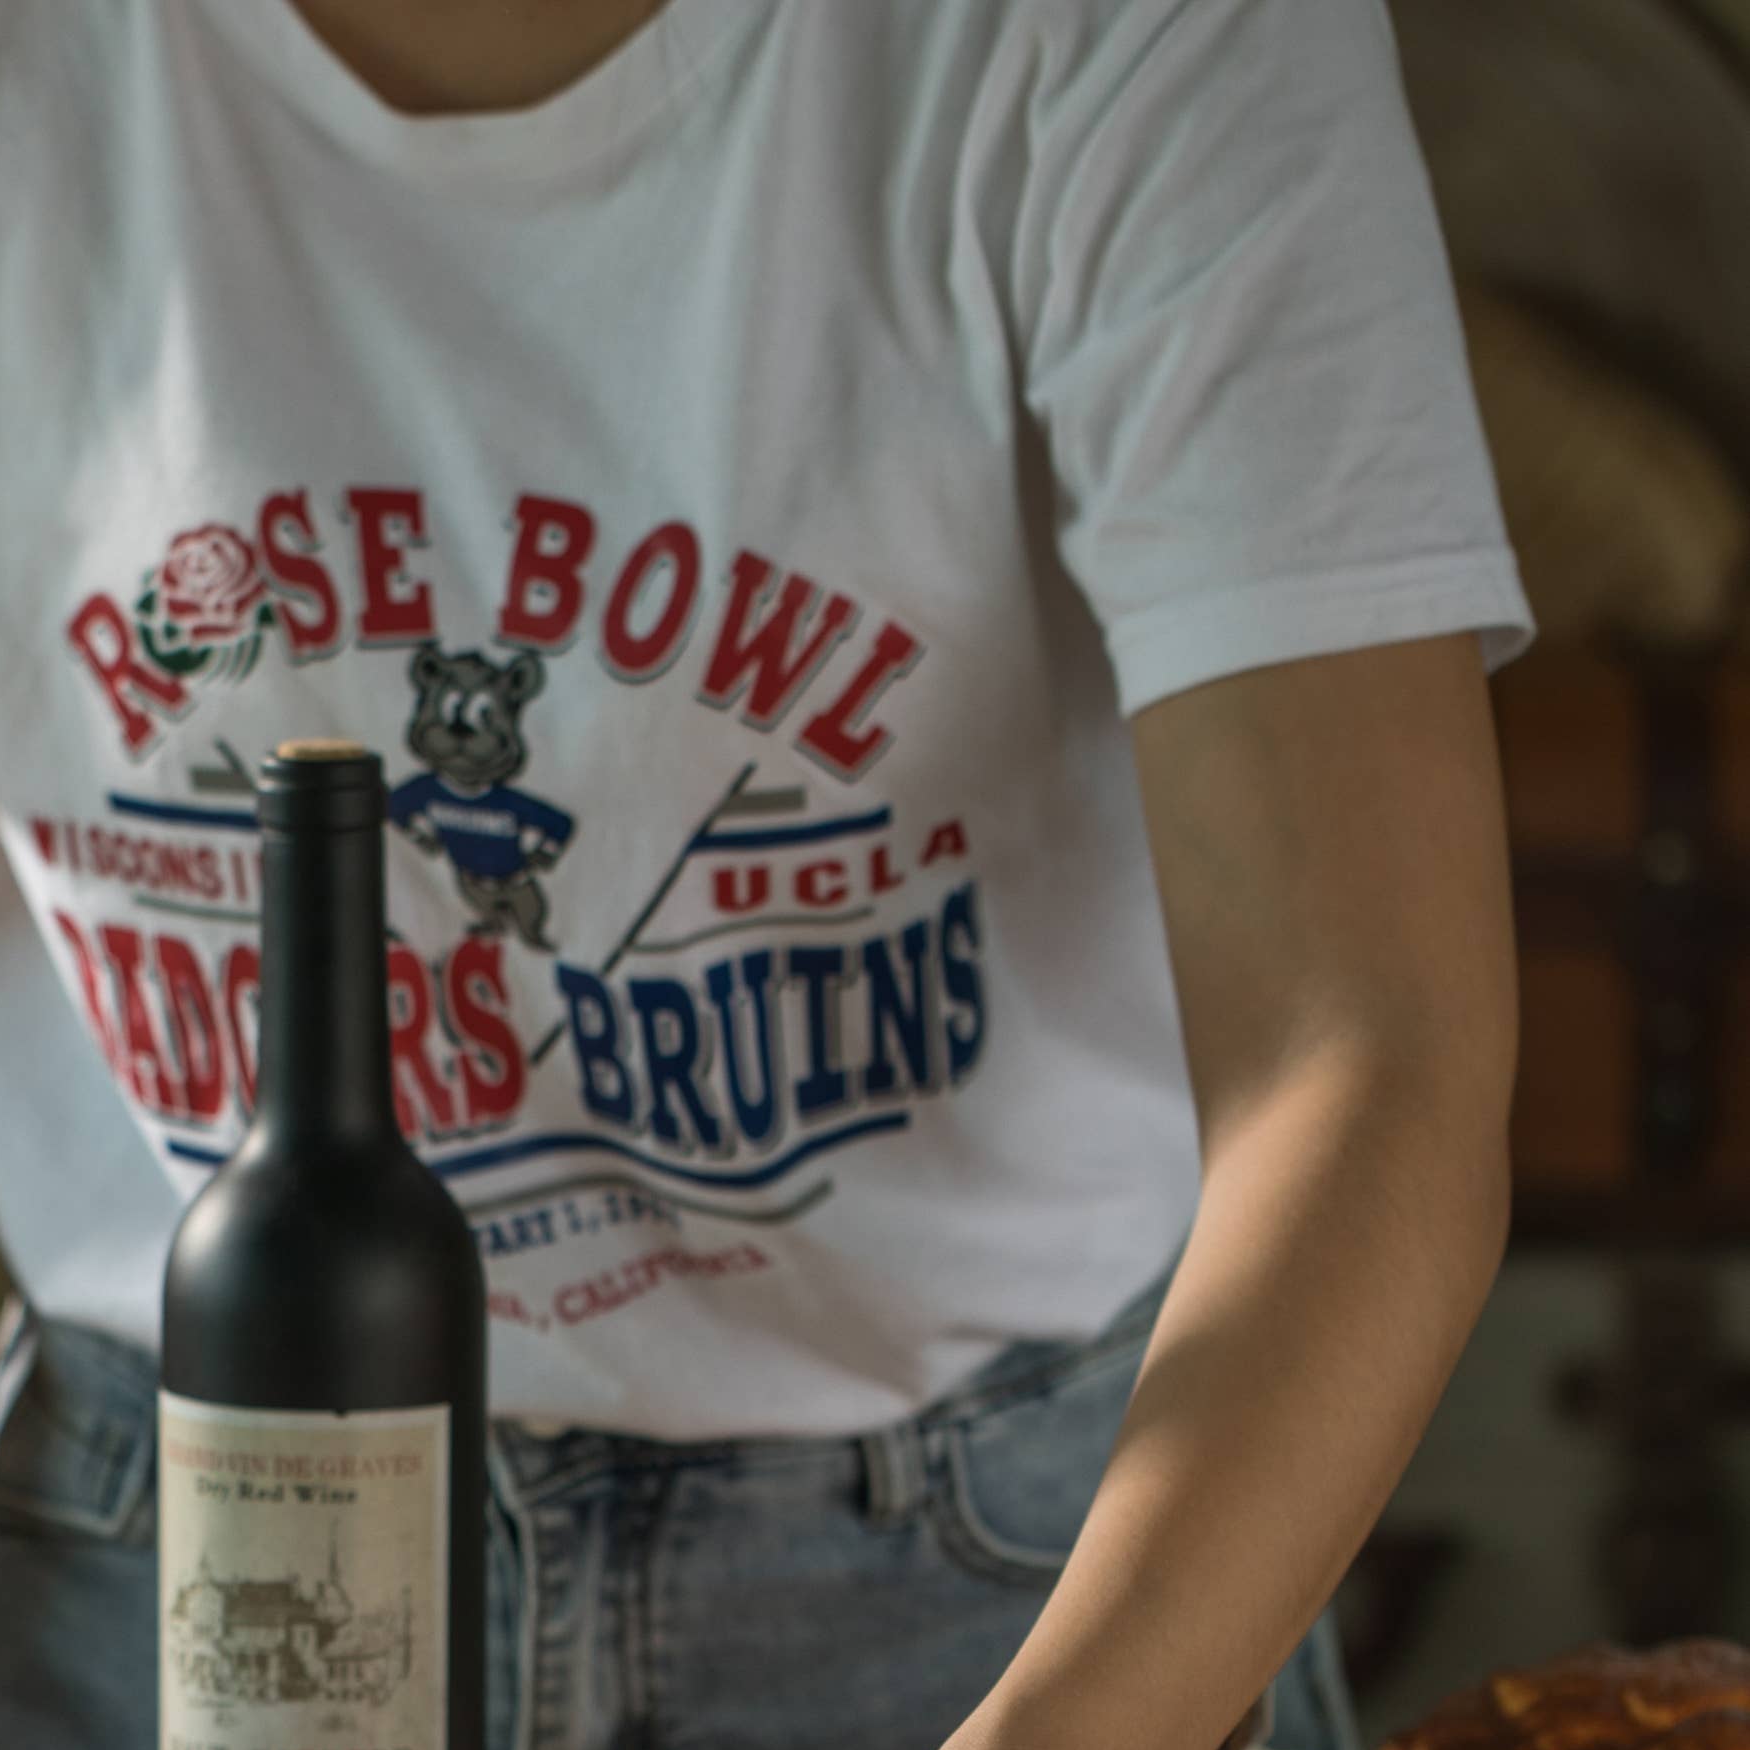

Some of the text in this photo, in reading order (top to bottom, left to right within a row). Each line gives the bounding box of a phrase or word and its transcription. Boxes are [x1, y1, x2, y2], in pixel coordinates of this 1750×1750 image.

[496, 492, 926, 780] BOWL
[30, 816, 260, 899] WISCONSI
[712, 819, 968, 914] UCLA
[556, 878, 988, 1150] BRUINS
[237, 1479, 286, 1503] Red
[293, 1483, 358, 1504] Wine
